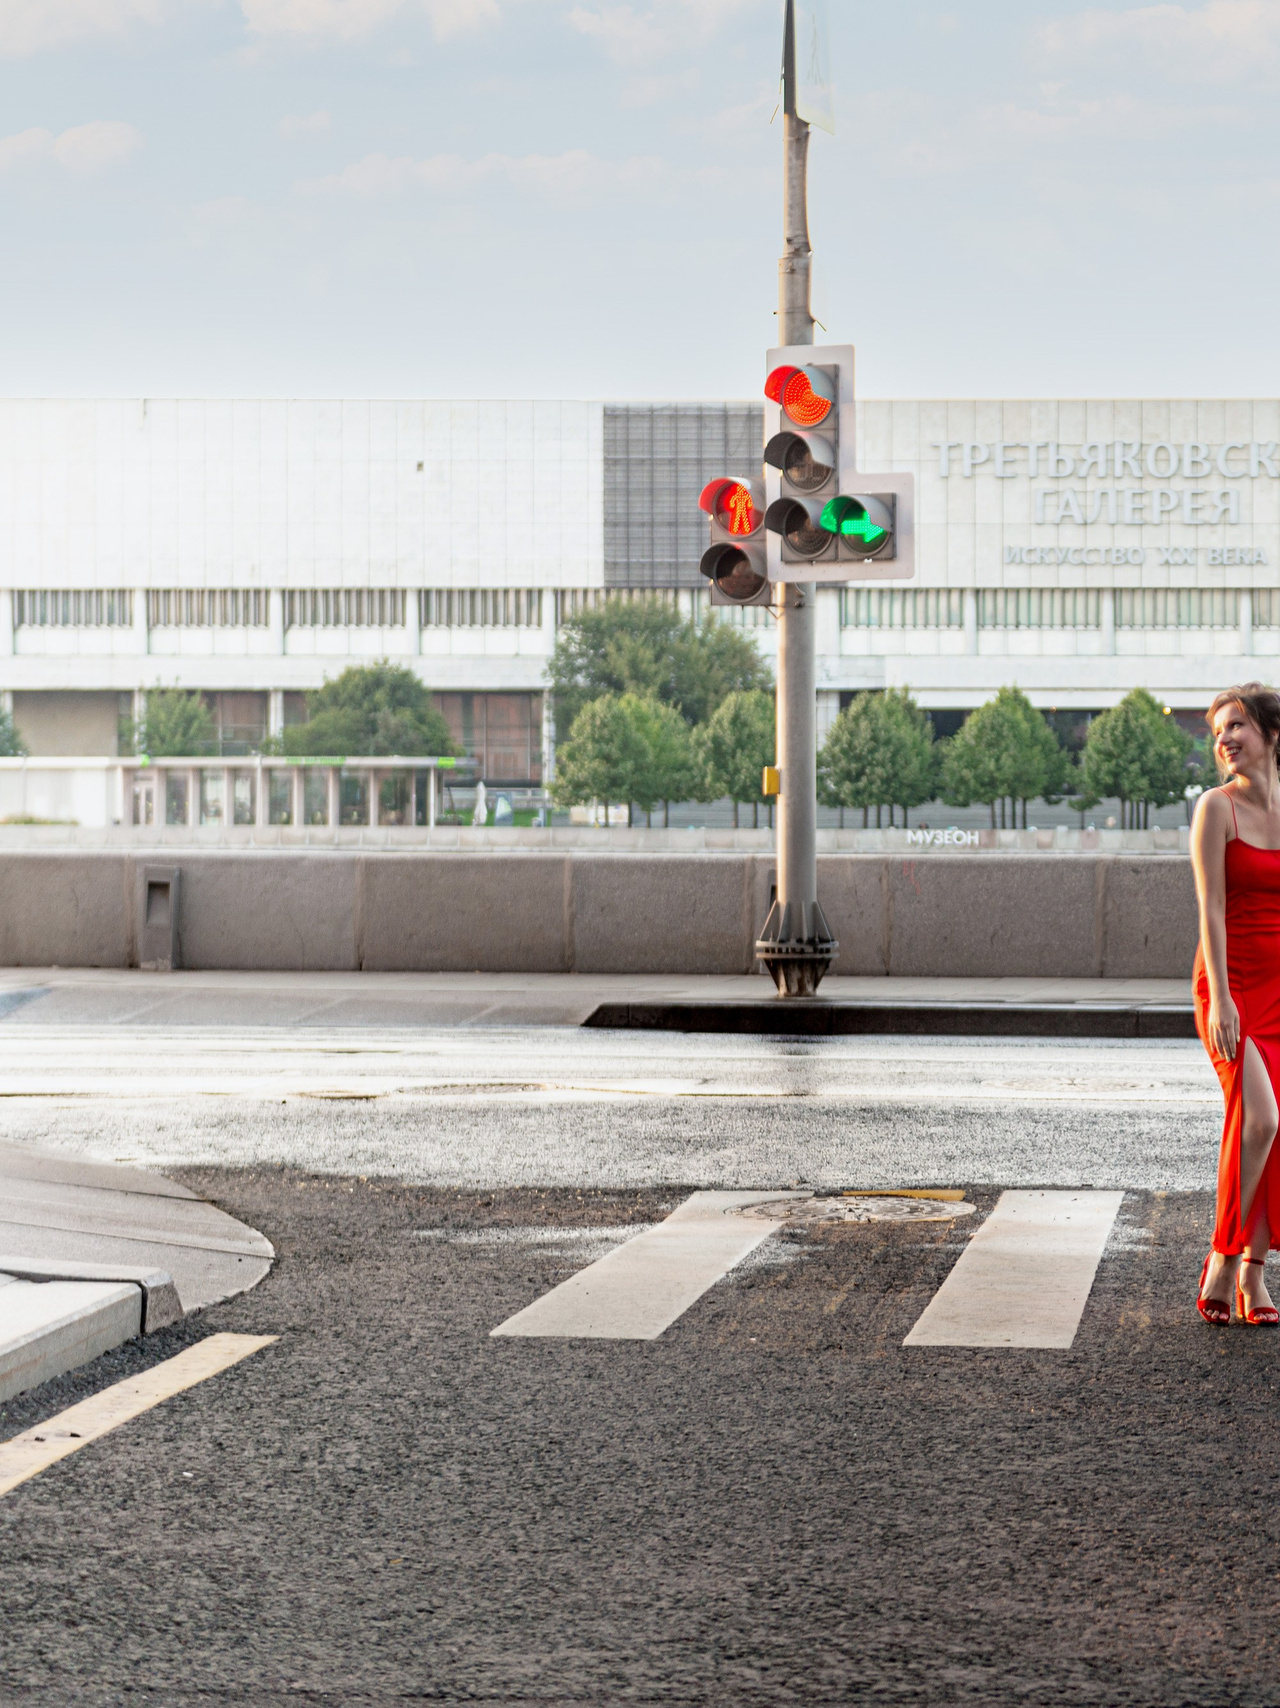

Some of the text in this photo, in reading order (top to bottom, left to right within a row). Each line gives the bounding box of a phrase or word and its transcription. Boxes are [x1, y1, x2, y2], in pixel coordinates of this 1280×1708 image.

[1035, 488, 1240, 525] ГАЛЕРЕЯ
[1003, 546, 1146, 565] ИСКУССТВО
[1207, 546, 1268, 565] ВЕКА
[906, 829, 979, 846] МУЗЕОН
